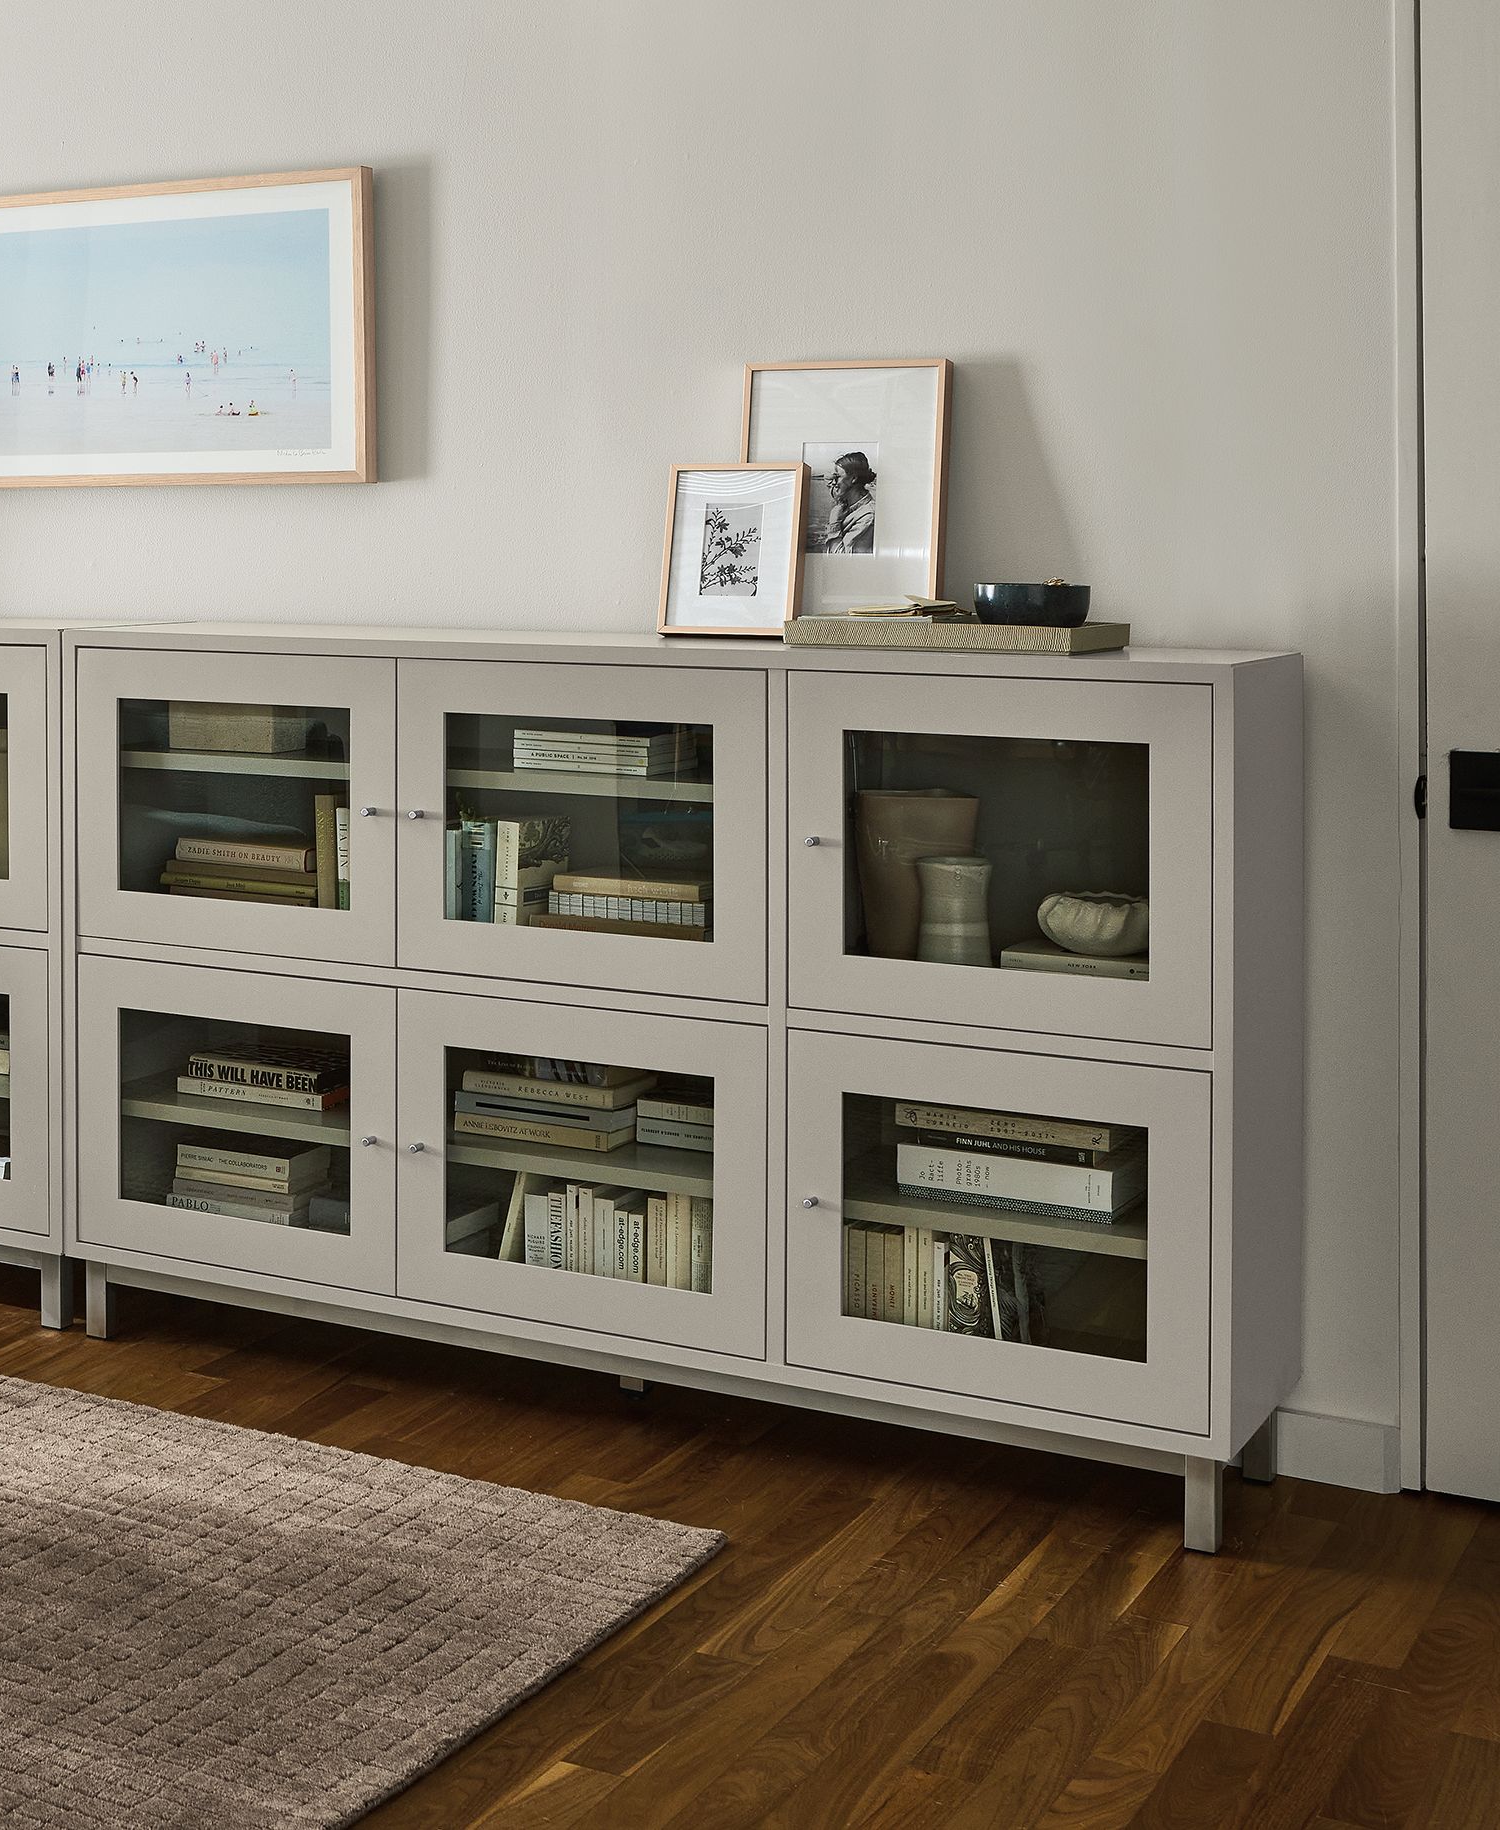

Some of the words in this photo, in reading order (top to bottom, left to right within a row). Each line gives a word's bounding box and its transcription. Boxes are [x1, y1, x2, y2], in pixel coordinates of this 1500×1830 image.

[338, 823, 348, 841] HA
[187, 846, 210, 856] ZADIE
[211, 850, 236, 858] SMITH
[251, 853, 281, 863] BEAUTY
[338, 846, 349, 867] JIN
[188, 1060, 215, 1079] THIS
[217, 1064, 247, 1083] WILL
[250, 1069, 283, 1088] HAVE
[285, 1074, 318, 1093] BEEN
[207, 1085, 246, 1096] PATTERN
[518, 1085, 559, 1097] REBECCA
[565, 1092, 589, 1101] WEST
[926, 1111, 957, 1120] MARIA
[926, 1119, 969, 1129] CORNEJO
[990, 1120, 1016, 1128] ZERO
[463, 1120, 484, 1130] ANNIE
[485, 1122, 518, 1134] LEIBOVITZ
[519, 1127, 530, 1135] AT
[529, 1128, 551, 1139] WORK
[956, 1137, 973, 1146] FINN
[974, 1139, 990, 1148] JUHL
[992, 1141, 1008, 1151] AND
[1009, 1144, 1021, 1152] HIS
[1022, 1146, 1046, 1156] HOUSE
[181, 1153, 197, 1161] PIERRE
[228, 1160, 268, 1171] COLLABORATORS
[919, 1170, 926, 1180] Jo
[965, 1160, 973, 1187] graphs
[973, 1165, 981, 1188] 1980s
[172, 1196, 209, 1211] PABLO
[617, 1217, 626, 1270] at-edge.com
[631, 1220, 641, 1274] at-edge.com
